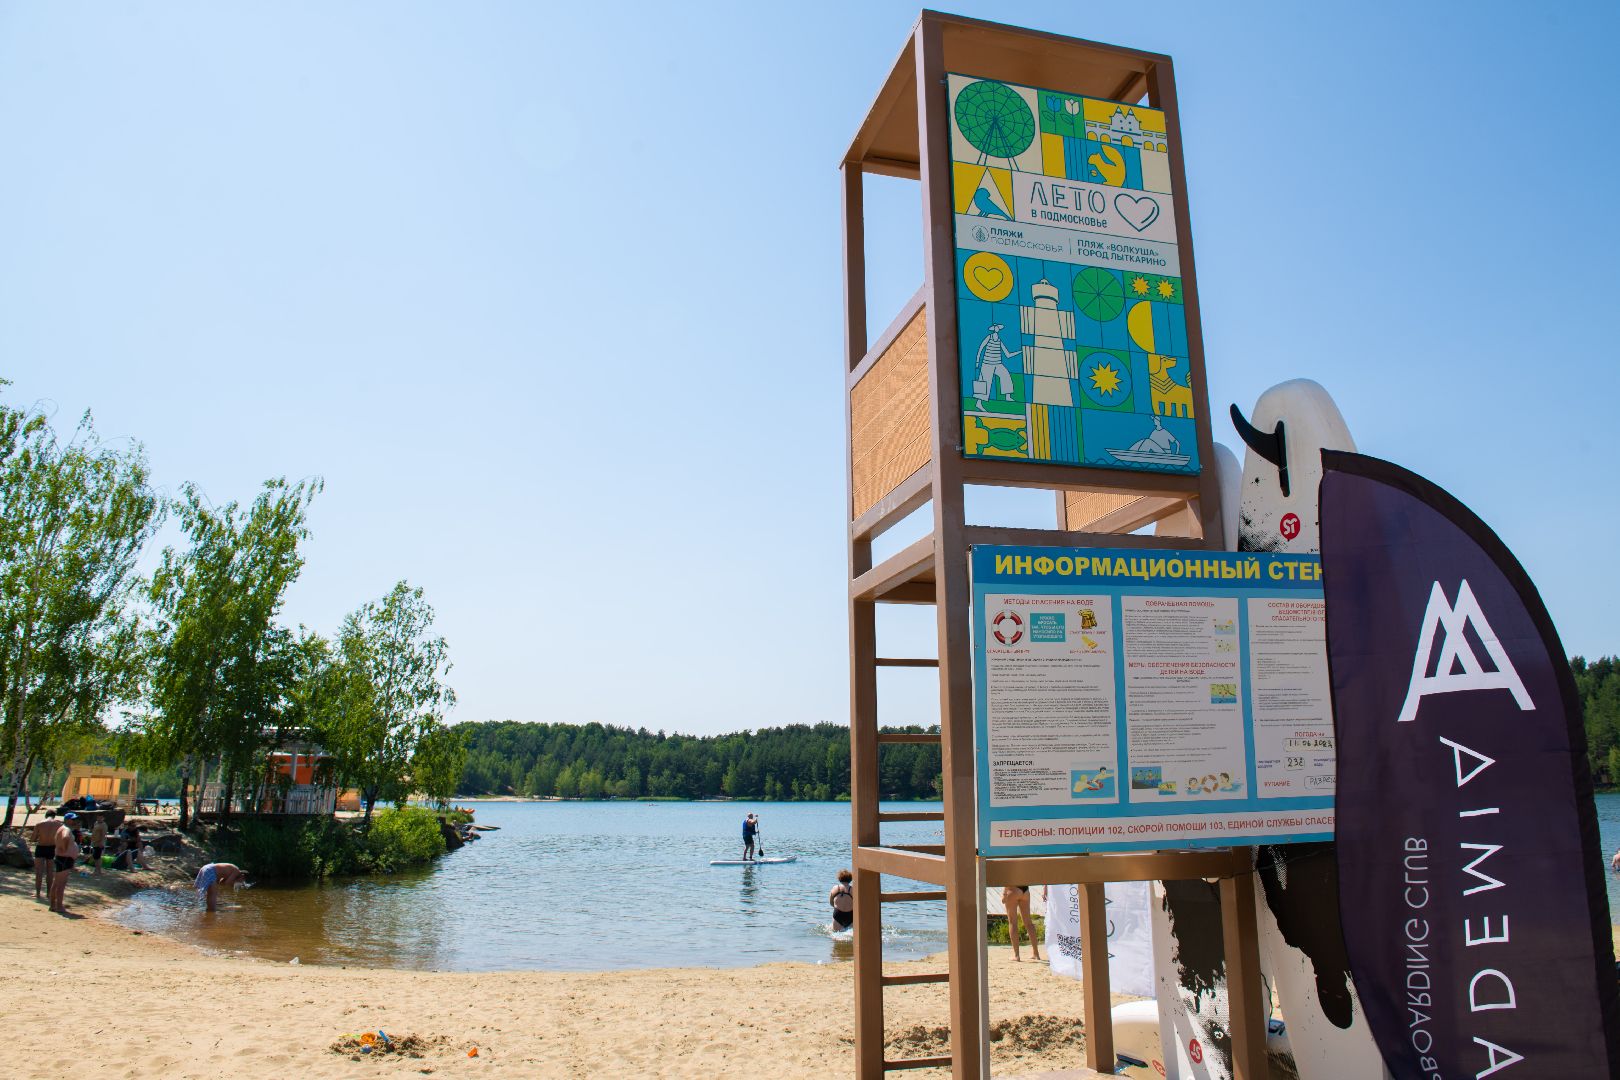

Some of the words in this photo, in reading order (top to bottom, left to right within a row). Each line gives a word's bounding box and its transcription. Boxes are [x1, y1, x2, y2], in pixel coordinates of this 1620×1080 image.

[1030, 181, 1105, 214] ЛЕТО
[990, 227, 1023, 238] ПЛЯЖИ
[990, 237, 1064, 253] ПОДМОСКОВЬЯ
[1077, 239, 1104, 250] ПЛЯЖ
[1106, 243, 1159, 256] «ВОЛКУША»
[1078, 248, 1109, 260] ГОРОД
[1110, 252, 1166, 267] ЛЫТКАРИНО
[995, 555, 1261, 581] ИНФОРМАЦИОННЫЙ
[998, 827, 1056, 838] ТЕЛЕФОНЫ:
[1058, 826, 1105, 837] ПОЛИЦИИ
[1108, 826, 1125, 835] 102,
[1127, 823, 1164, 834] СКОРОЙ
[1209, 821, 1226, 831] 103,
[1228, 819, 1264, 831] ЕДИНОЙ
[1266, 818, 1303, 828] СЛУЖБЫ
[1305, 816, 1336, 826] СПАСЕ
